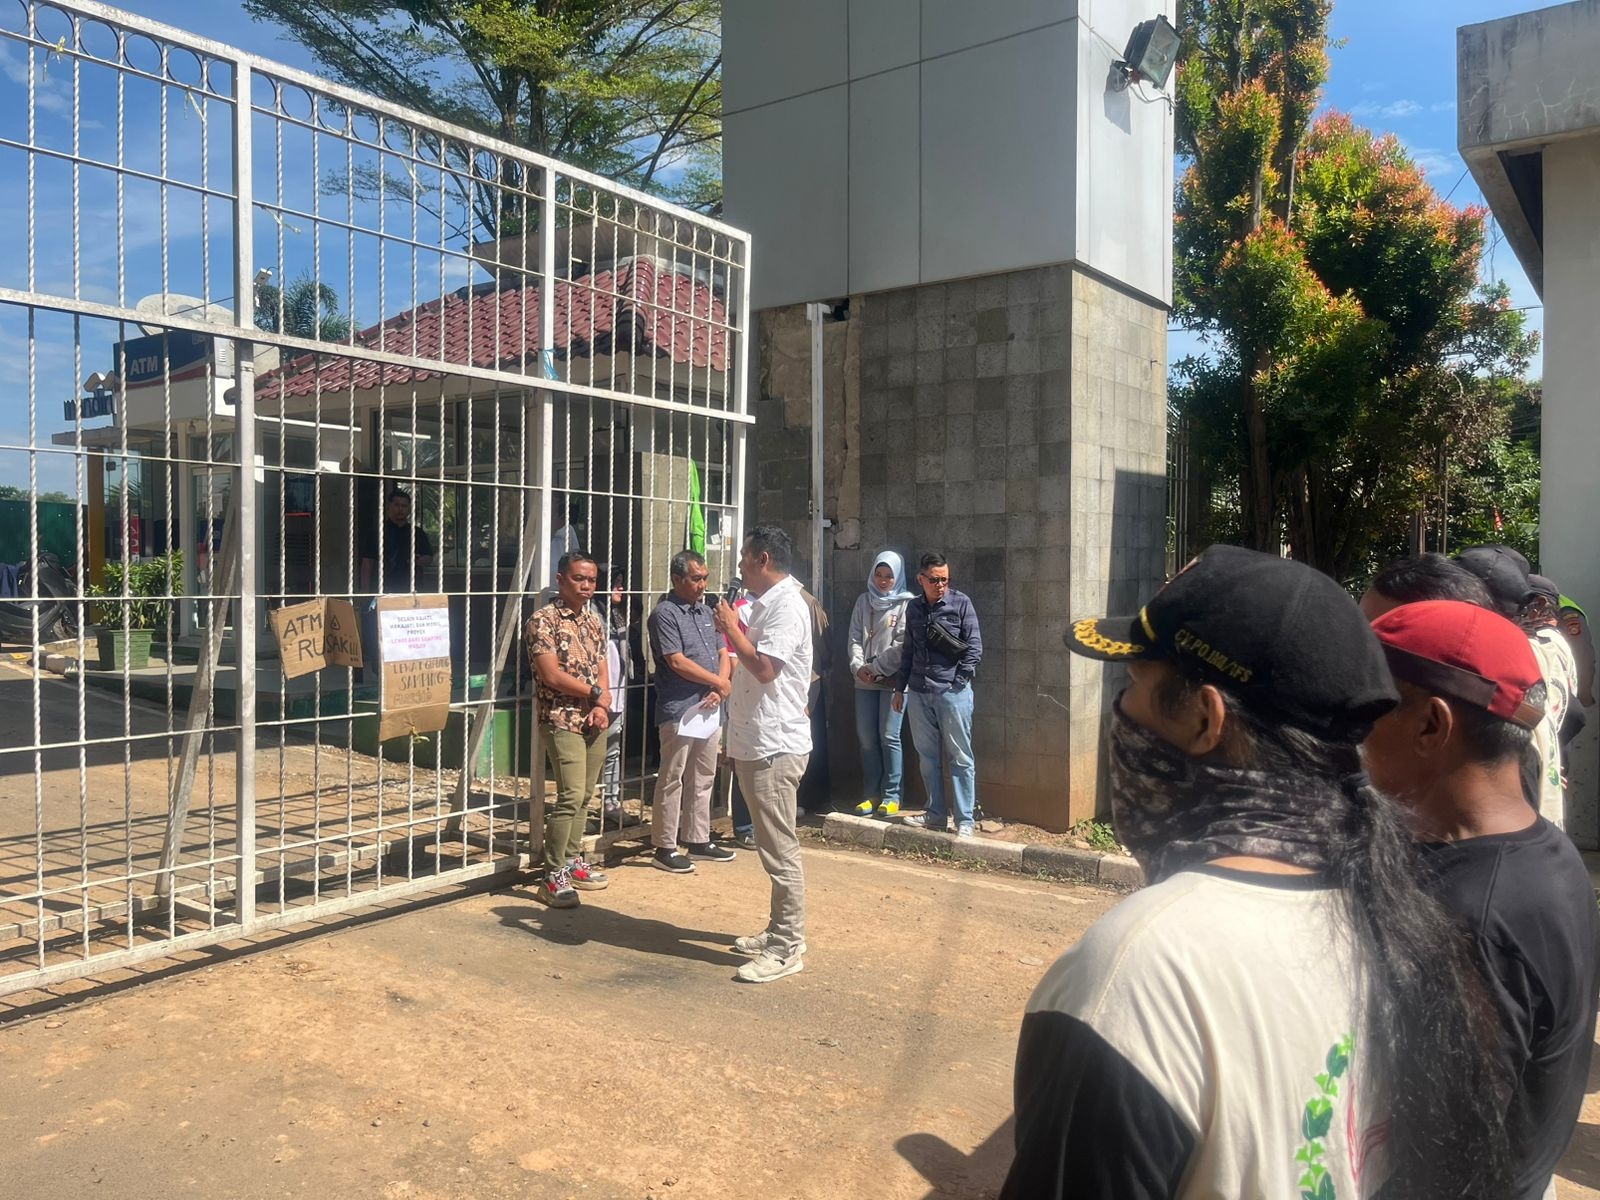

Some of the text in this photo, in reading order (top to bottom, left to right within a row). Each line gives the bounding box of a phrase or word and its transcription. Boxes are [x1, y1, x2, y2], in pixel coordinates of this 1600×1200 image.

[130, 355, 159, 376] ATM
[283, 613, 322, 639] ATM
[399, 671, 445, 691] SAMPING
